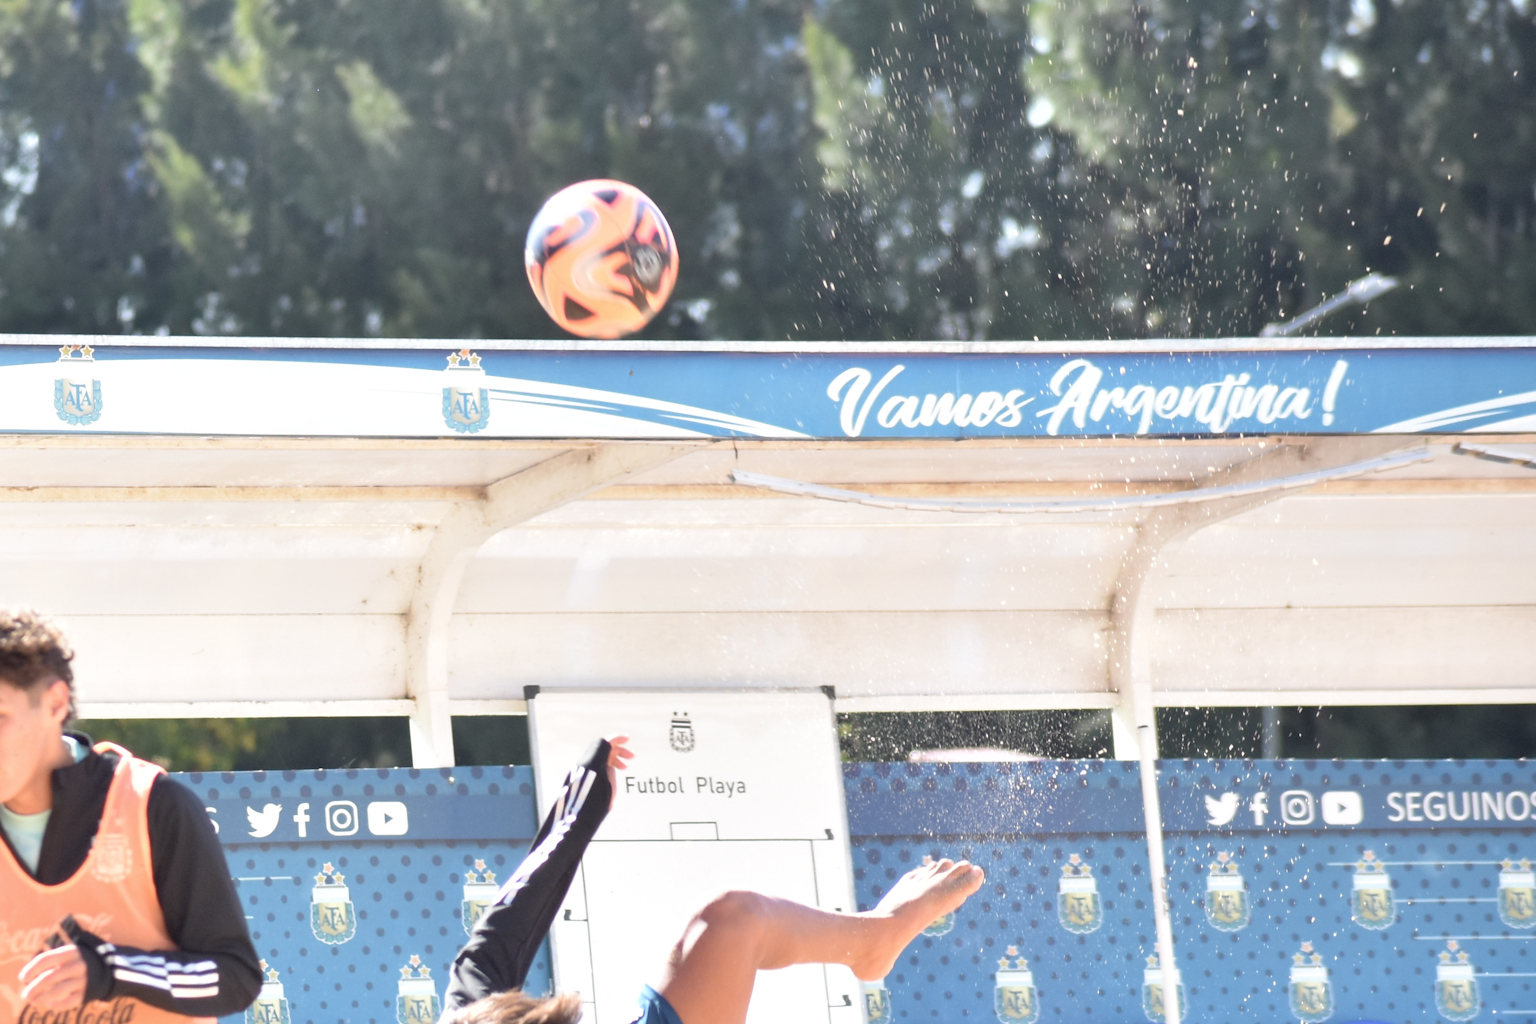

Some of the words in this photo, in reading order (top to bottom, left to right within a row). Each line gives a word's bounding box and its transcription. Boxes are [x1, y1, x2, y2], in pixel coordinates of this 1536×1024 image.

[827, 364, 1035, 437] Vamos
[625, 776, 685, 794] Futbol
[696, 776, 747, 798] Playa
